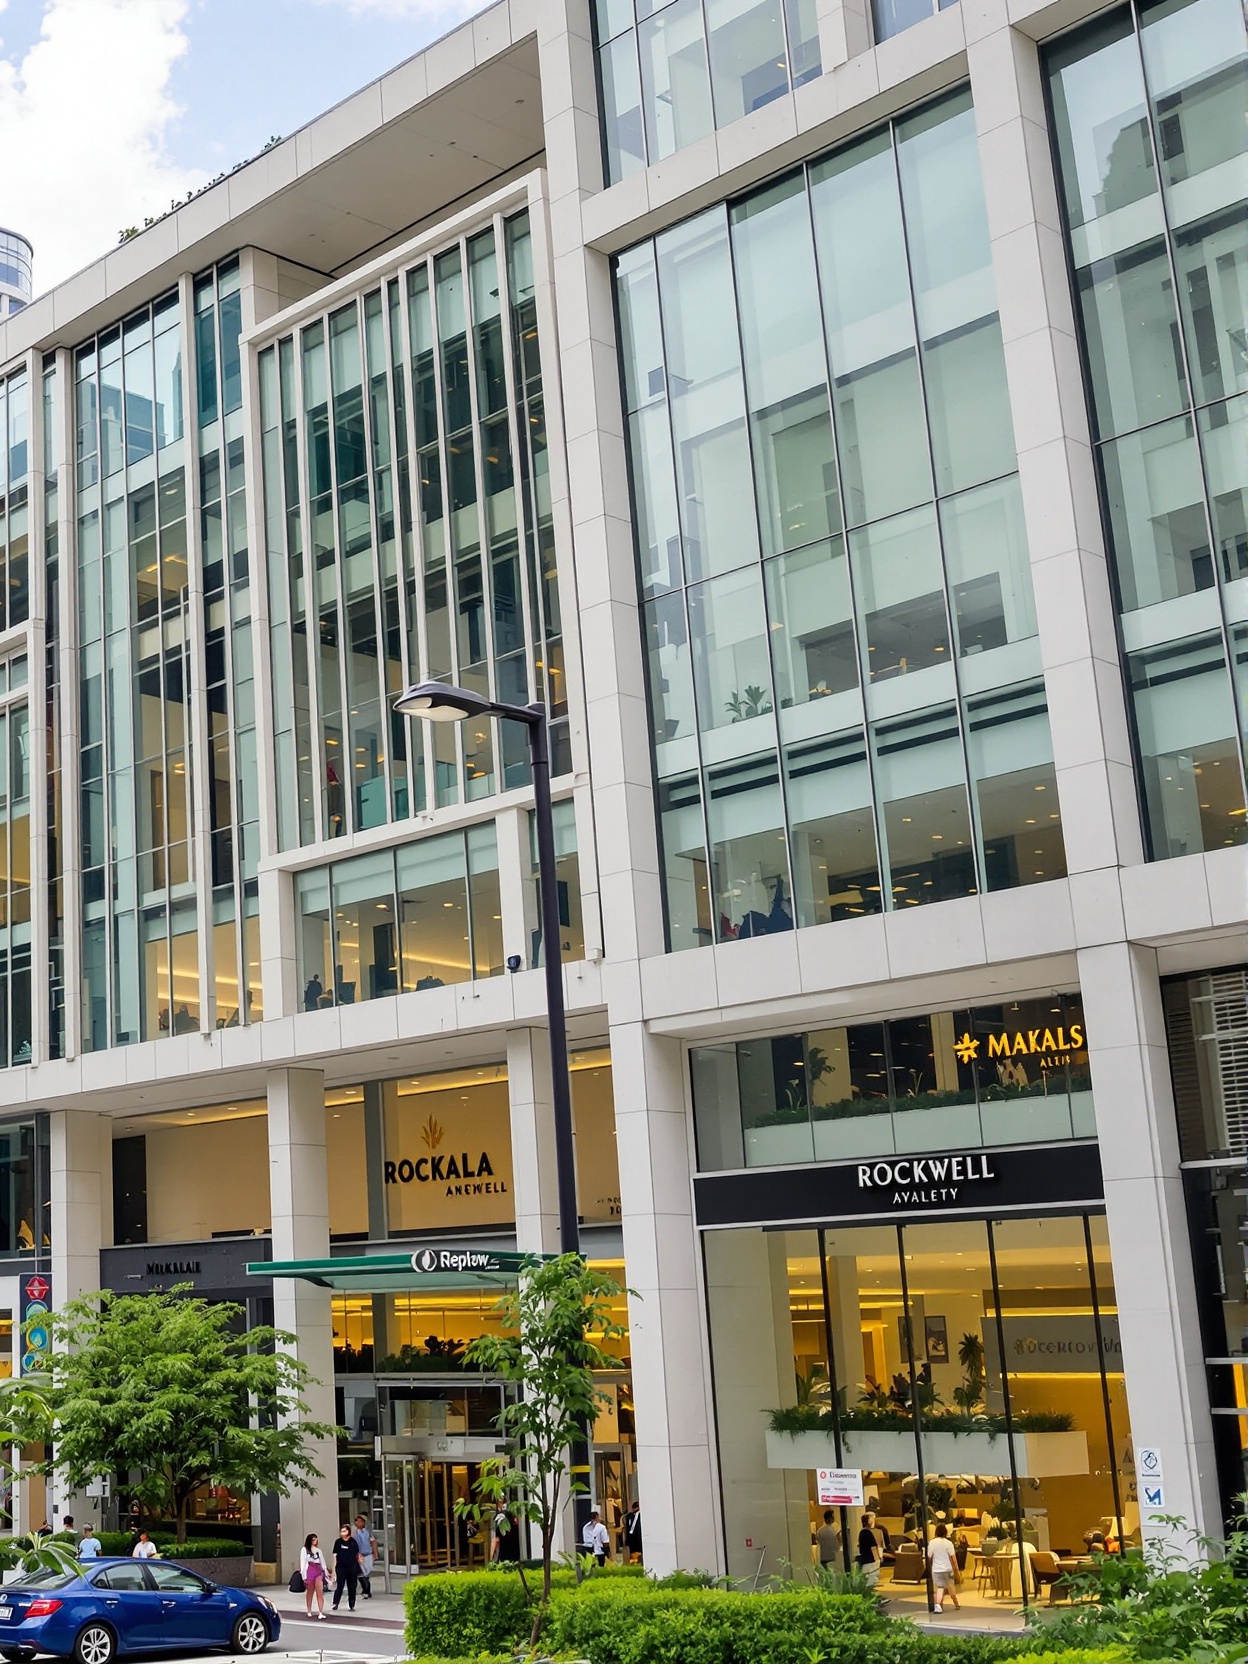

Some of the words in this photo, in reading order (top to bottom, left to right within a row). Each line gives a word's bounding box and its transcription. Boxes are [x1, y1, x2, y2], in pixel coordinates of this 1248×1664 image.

[988, 1025, 1083, 1058] MAKALS
[384, 1151, 494, 1185] ROCKALA
[857, 1155, 995, 1188] ROCKWELL
